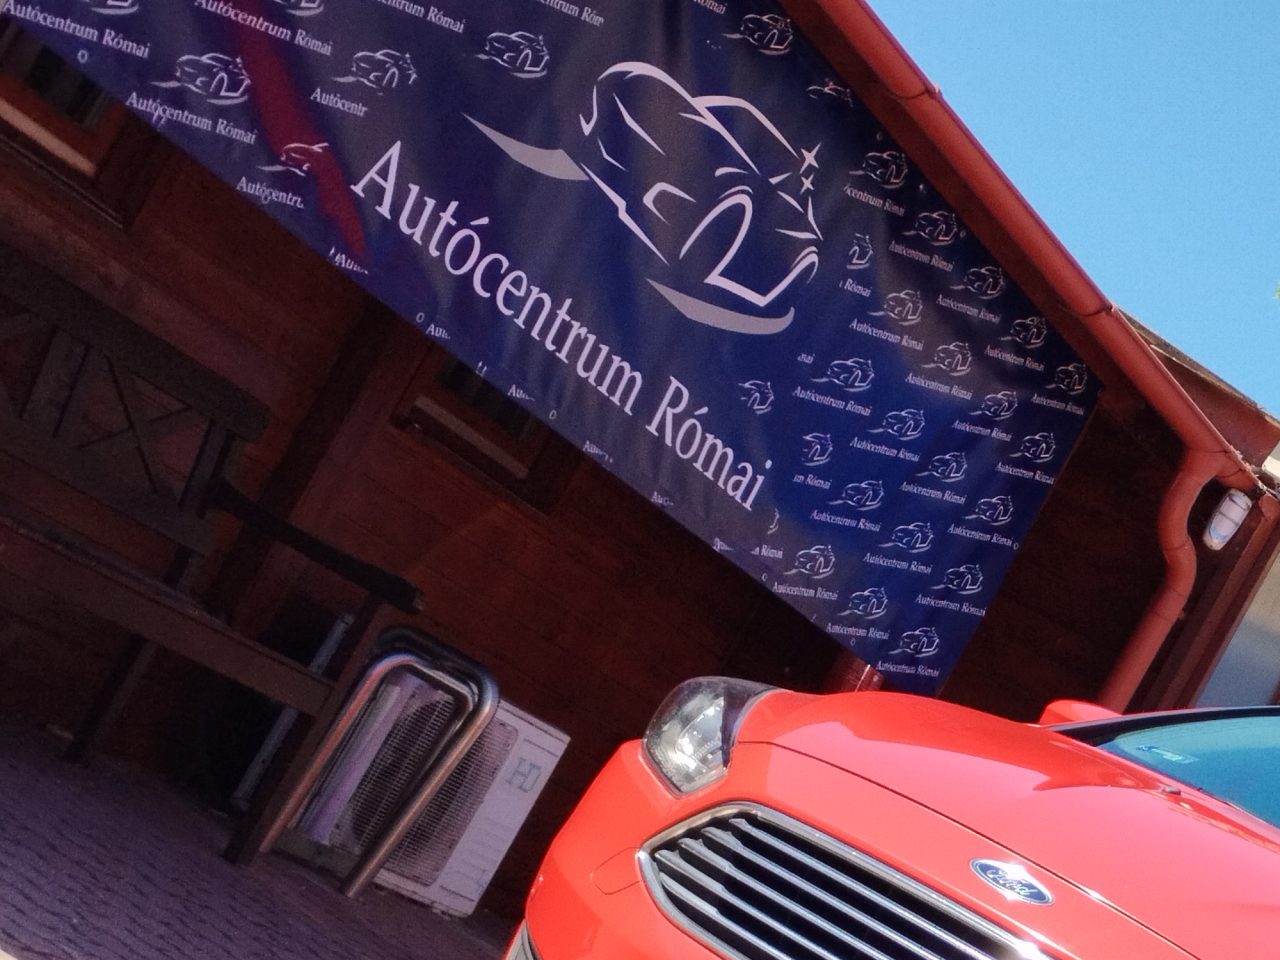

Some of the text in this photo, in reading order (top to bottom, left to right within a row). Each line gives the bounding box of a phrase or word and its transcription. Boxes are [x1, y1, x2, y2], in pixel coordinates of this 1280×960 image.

[3, 0, 151, 59] Autócentrum Római
[295, 30, 334, 57] Római
[426, 6, 466, 33] Római
[126, 91, 258, 145] Autócentrum Római
[350, 140, 773, 511] Autócentrum Római
